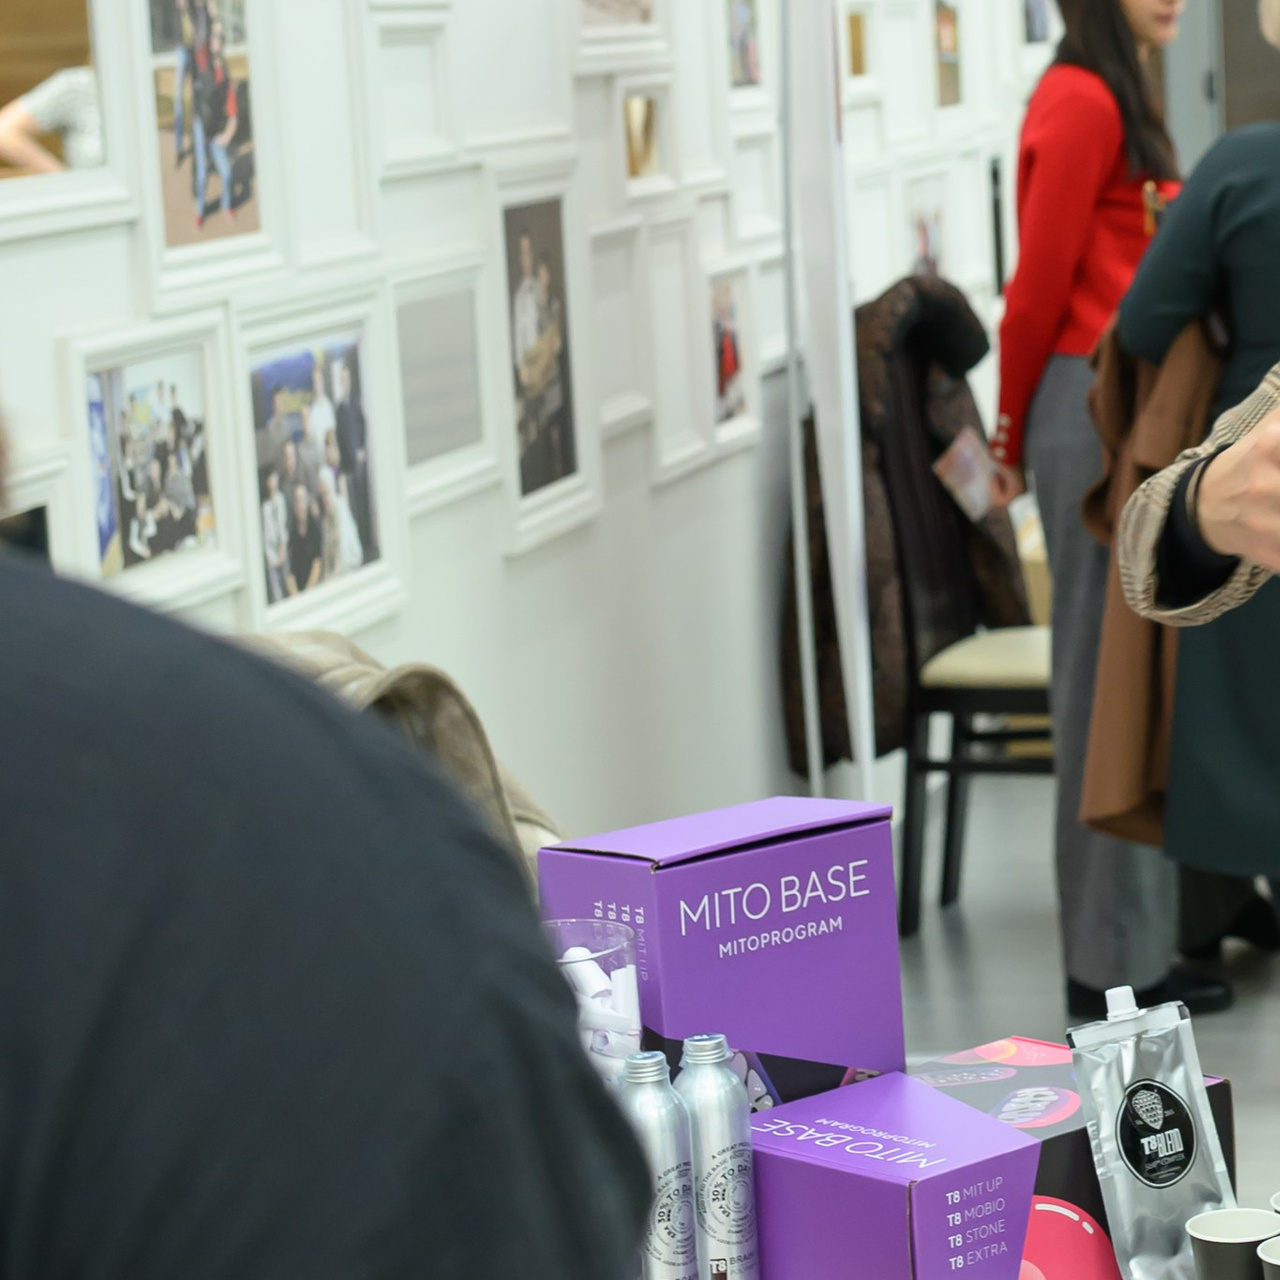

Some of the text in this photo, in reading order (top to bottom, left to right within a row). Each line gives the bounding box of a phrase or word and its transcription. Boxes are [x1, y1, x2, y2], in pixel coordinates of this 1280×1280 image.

[594, 900, 603, 918] T8
[607, 902, 616, 920] T8
[679, 859, 870, 936] MITO BASE
[621, 905, 630, 922] T8
[635, 907, 644, 924] T8
[718, 915, 843, 959] MITOPROGRAM
[750, 1118, 947, 1169] MITO BASE
[815, 1118, 937, 1149] MITOPROGRAM
[1140, 1135, 1157, 1155] T8
[945, 1176, 1003, 1205] T8 MIT UP
[946, 1198, 1006, 1227] T8 MOBIO
[948, 1219, 1006, 1249] T8 STONE
[709, 1261, 727, 1274] T8
[949, 1241, 1008, 1270] T8 EXTRA
